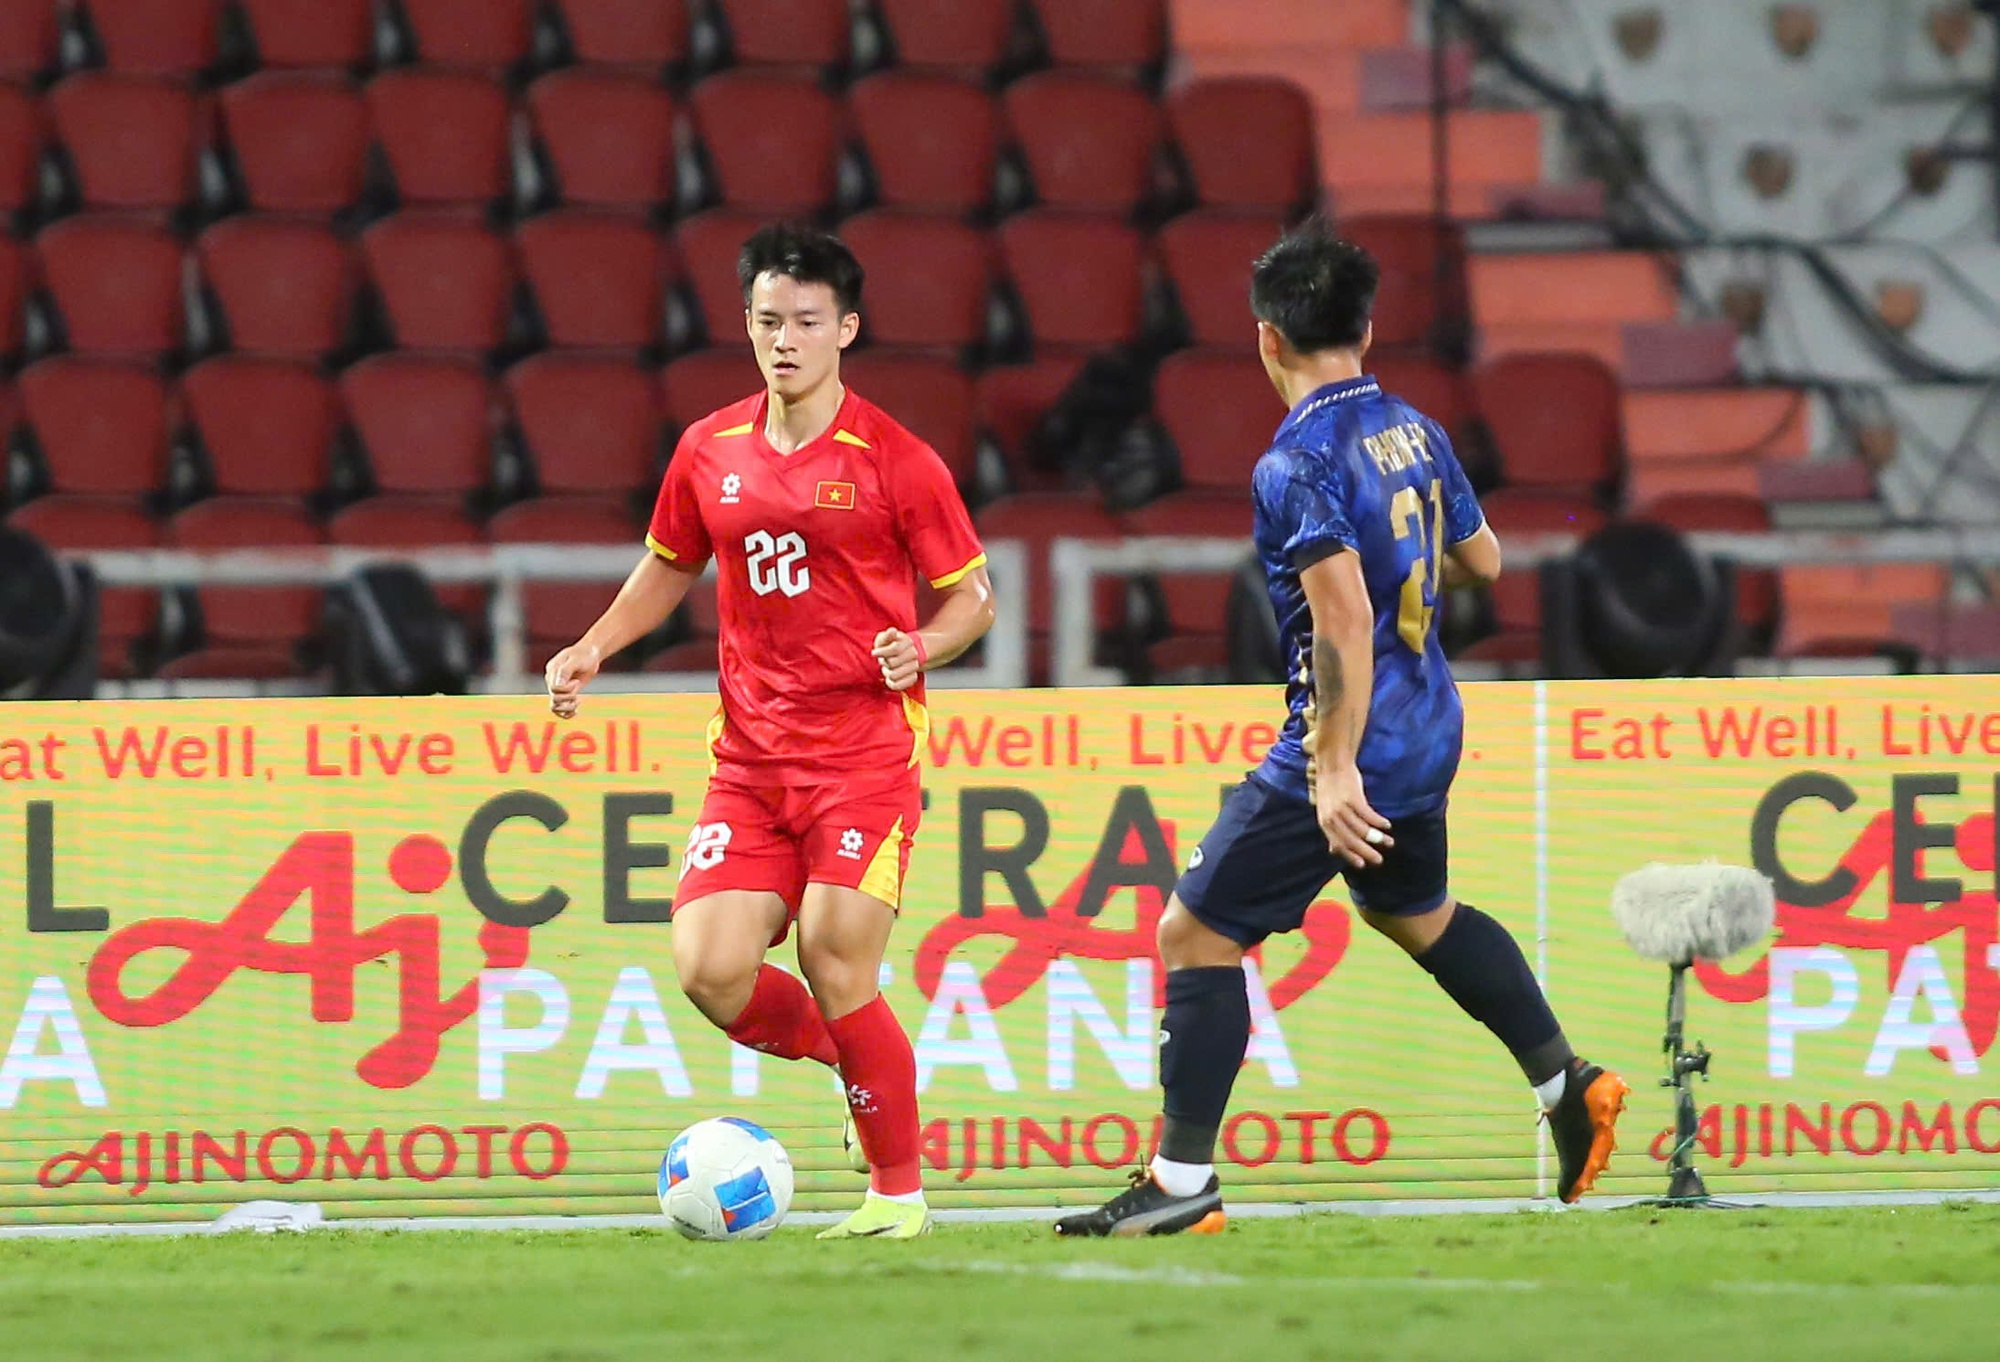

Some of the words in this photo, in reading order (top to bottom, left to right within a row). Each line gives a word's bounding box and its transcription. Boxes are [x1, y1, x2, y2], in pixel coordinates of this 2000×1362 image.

[744, 529, 811, 598] 22
[1390, 478, 1442, 654] 21
[92, 725, 274, 780] Well,
[306, 724, 455, 776] Live
[482, 720, 660, 773] Well.
[928, 714, 1098, 770] Well,
[1130, 713, 1278, 766] Live
[1571, 708, 1672, 761] Eat
[1698, 705, 1856, 760] Well,
[1751, 770, 2000, 906] CE
[1767, 944, 2000, 1077] PA
[36, 1122, 571, 1196] AJINOMOTO
[920, 1108, 1391, 1182] AJINOOTO
